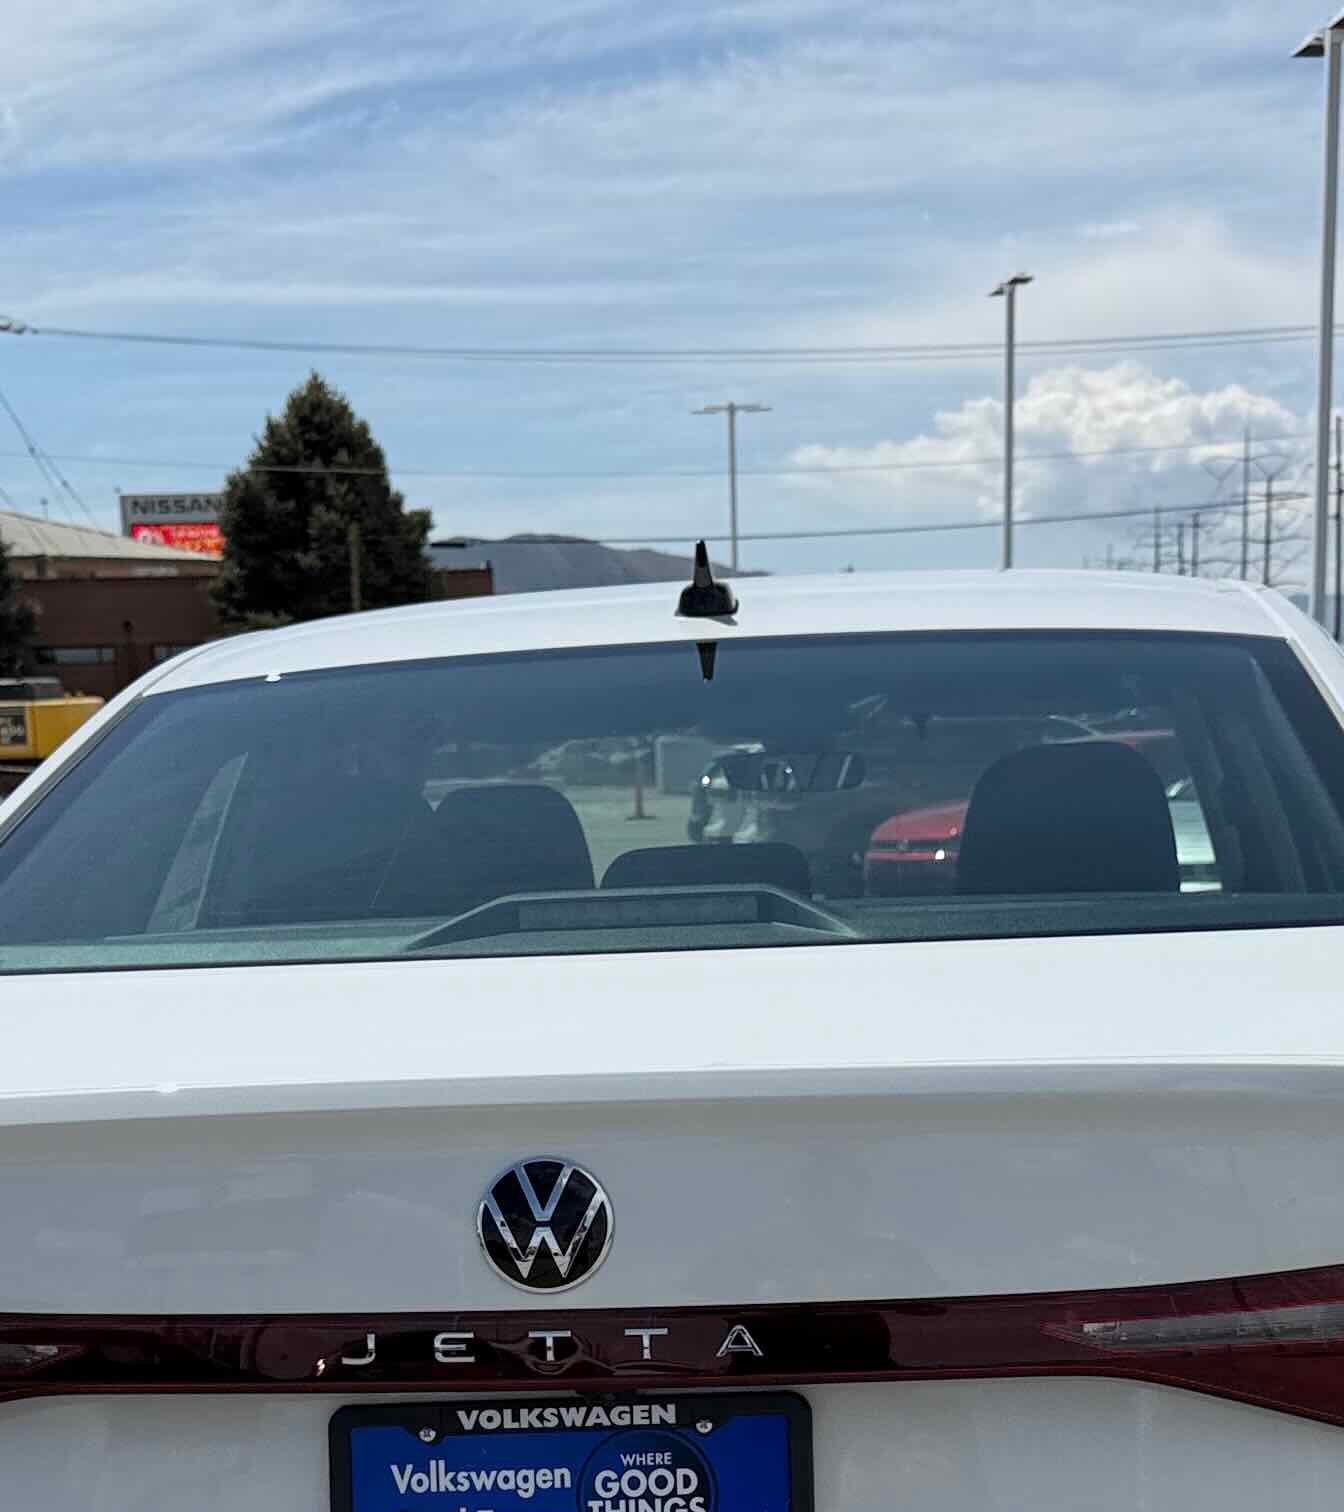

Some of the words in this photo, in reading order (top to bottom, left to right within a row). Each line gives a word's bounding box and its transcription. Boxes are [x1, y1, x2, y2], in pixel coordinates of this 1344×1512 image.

[130, 498, 223, 513] NISSAN
[479, 1160, 611, 1286] VW
[342, 1324, 764, 1365] JETTA
[457, 1404, 676, 1430] VOLKSWAGEN
[620, 1452, 672, 1466] WHERE
[390, 1460, 572, 1498] Volkswagen
[595, 1468, 698, 1498] GOOD
